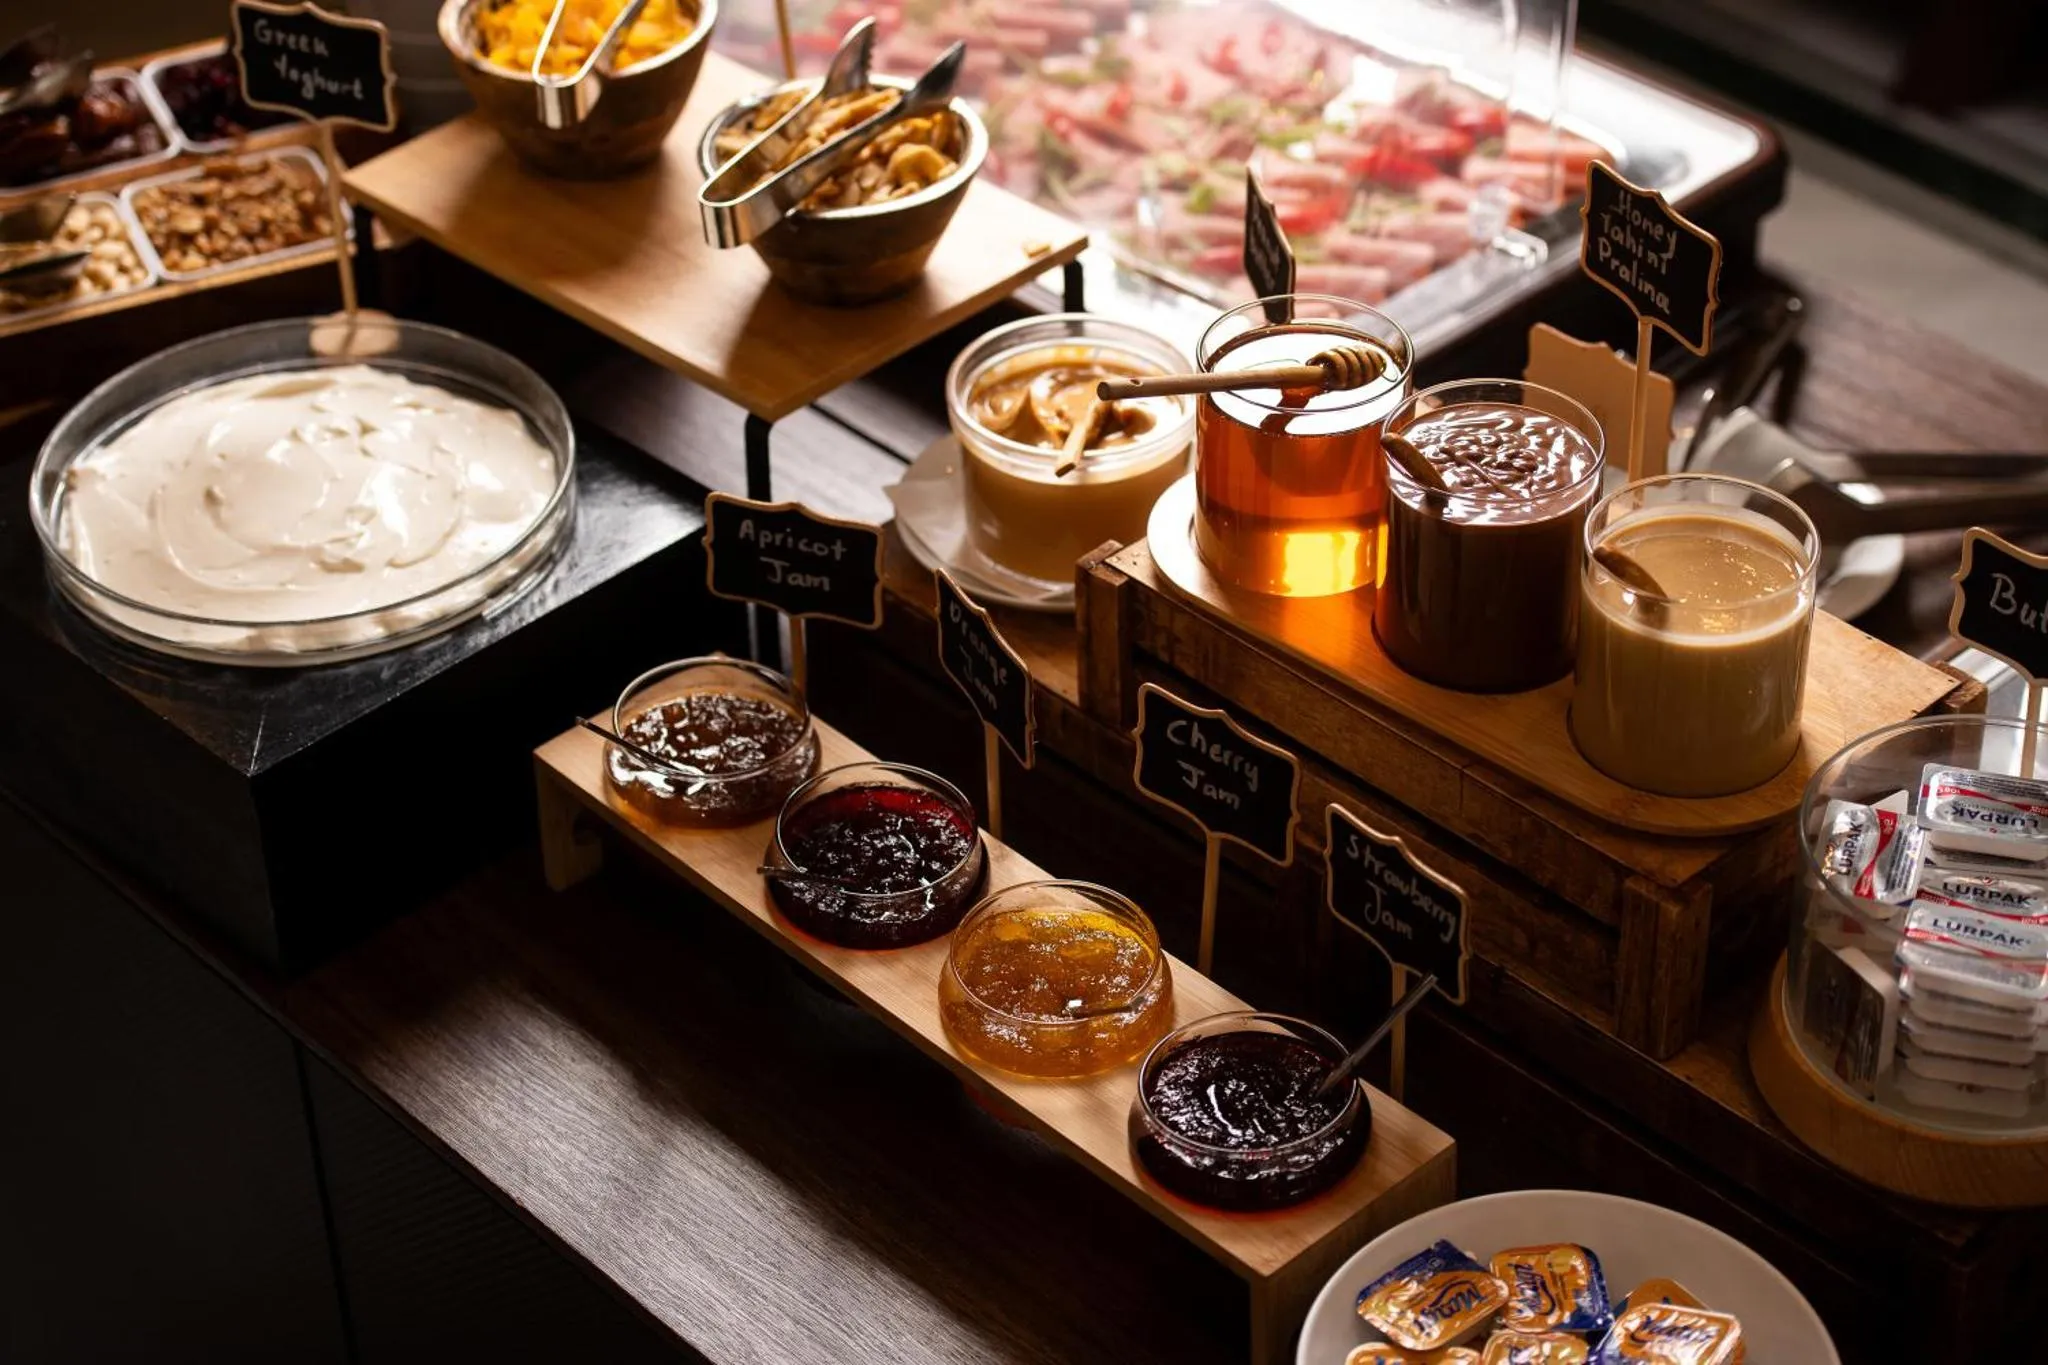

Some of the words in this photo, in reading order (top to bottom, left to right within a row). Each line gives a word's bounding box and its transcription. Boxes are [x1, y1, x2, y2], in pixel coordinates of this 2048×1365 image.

[273, 53, 364, 100] Yoghurt
[1610, 189, 1677, 260] Honey
[738, 518, 847, 561] Apricot
[759, 555, 831, 592] Jam
[1166, 719, 1259, 793] Cherry
[1176, 759, 1241, 811] Jam
[1952, 805, 2039, 829] LURPAK
[1837, 822, 1864, 876] LURPAK
[1346, 834, 1456, 944] Strawberry
[1364, 879, 1413, 940] Jam
[1942, 881, 2032, 906] LURPAK
[1932, 918, 2025, 947] LURPAK
